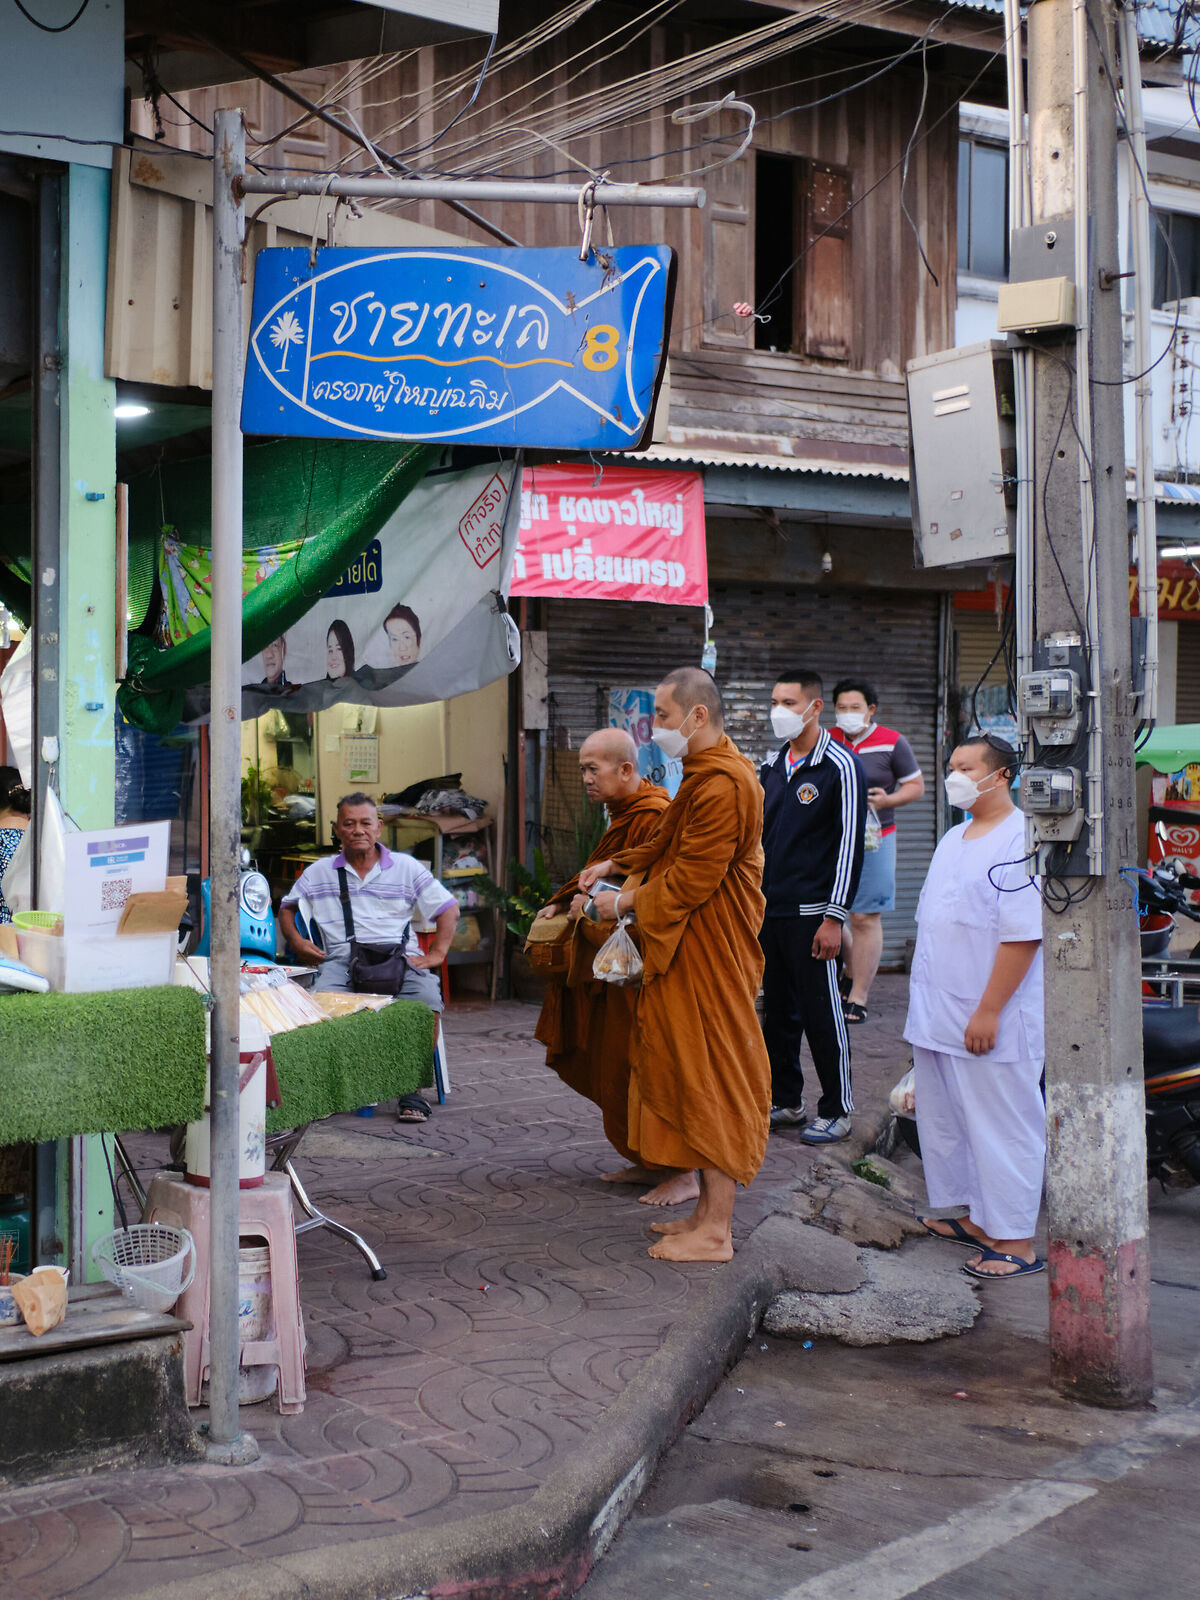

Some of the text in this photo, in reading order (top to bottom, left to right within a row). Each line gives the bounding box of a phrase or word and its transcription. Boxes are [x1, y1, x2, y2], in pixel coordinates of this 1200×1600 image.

[329, 291, 550, 350] ชายทะเล
[582, 324, 620, 372] 8
[312, 370, 509, 415] ตรอกผู้ใหญ่เฉลิม
[542, 537, 686, 587] เปลี่ยนทรง
